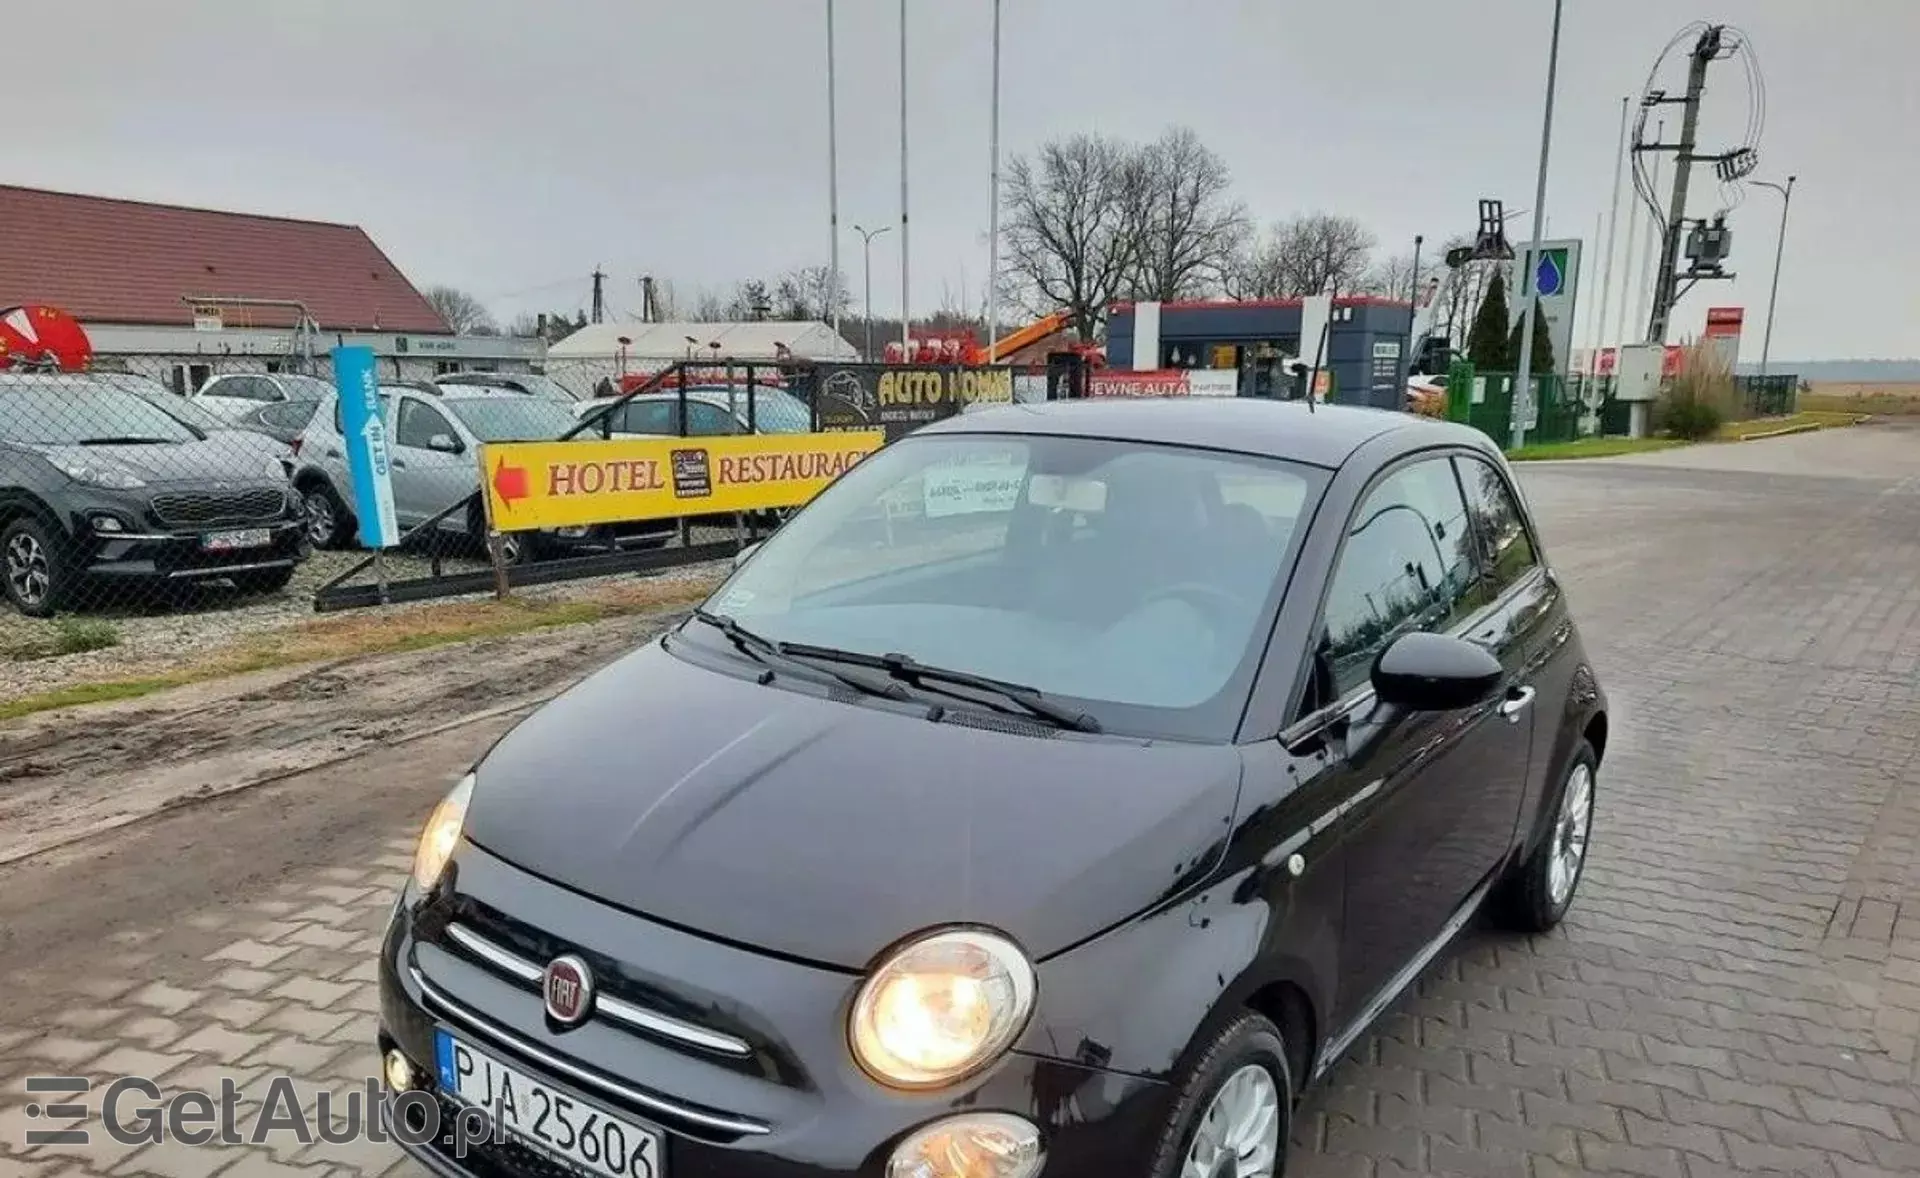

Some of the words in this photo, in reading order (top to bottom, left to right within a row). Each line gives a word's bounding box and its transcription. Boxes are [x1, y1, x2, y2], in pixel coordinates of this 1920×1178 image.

[878, 371, 942, 405] AUTO
[1143, 382, 1188, 396] AUTA
[547, 461, 665, 496] HOTEL
[718, 451, 866, 484] RESTAURAC
[551, 976, 578, 1010] FIAT
[454, 1045, 519, 1125] PJA
[531, 1087, 652, 1178] 25606
